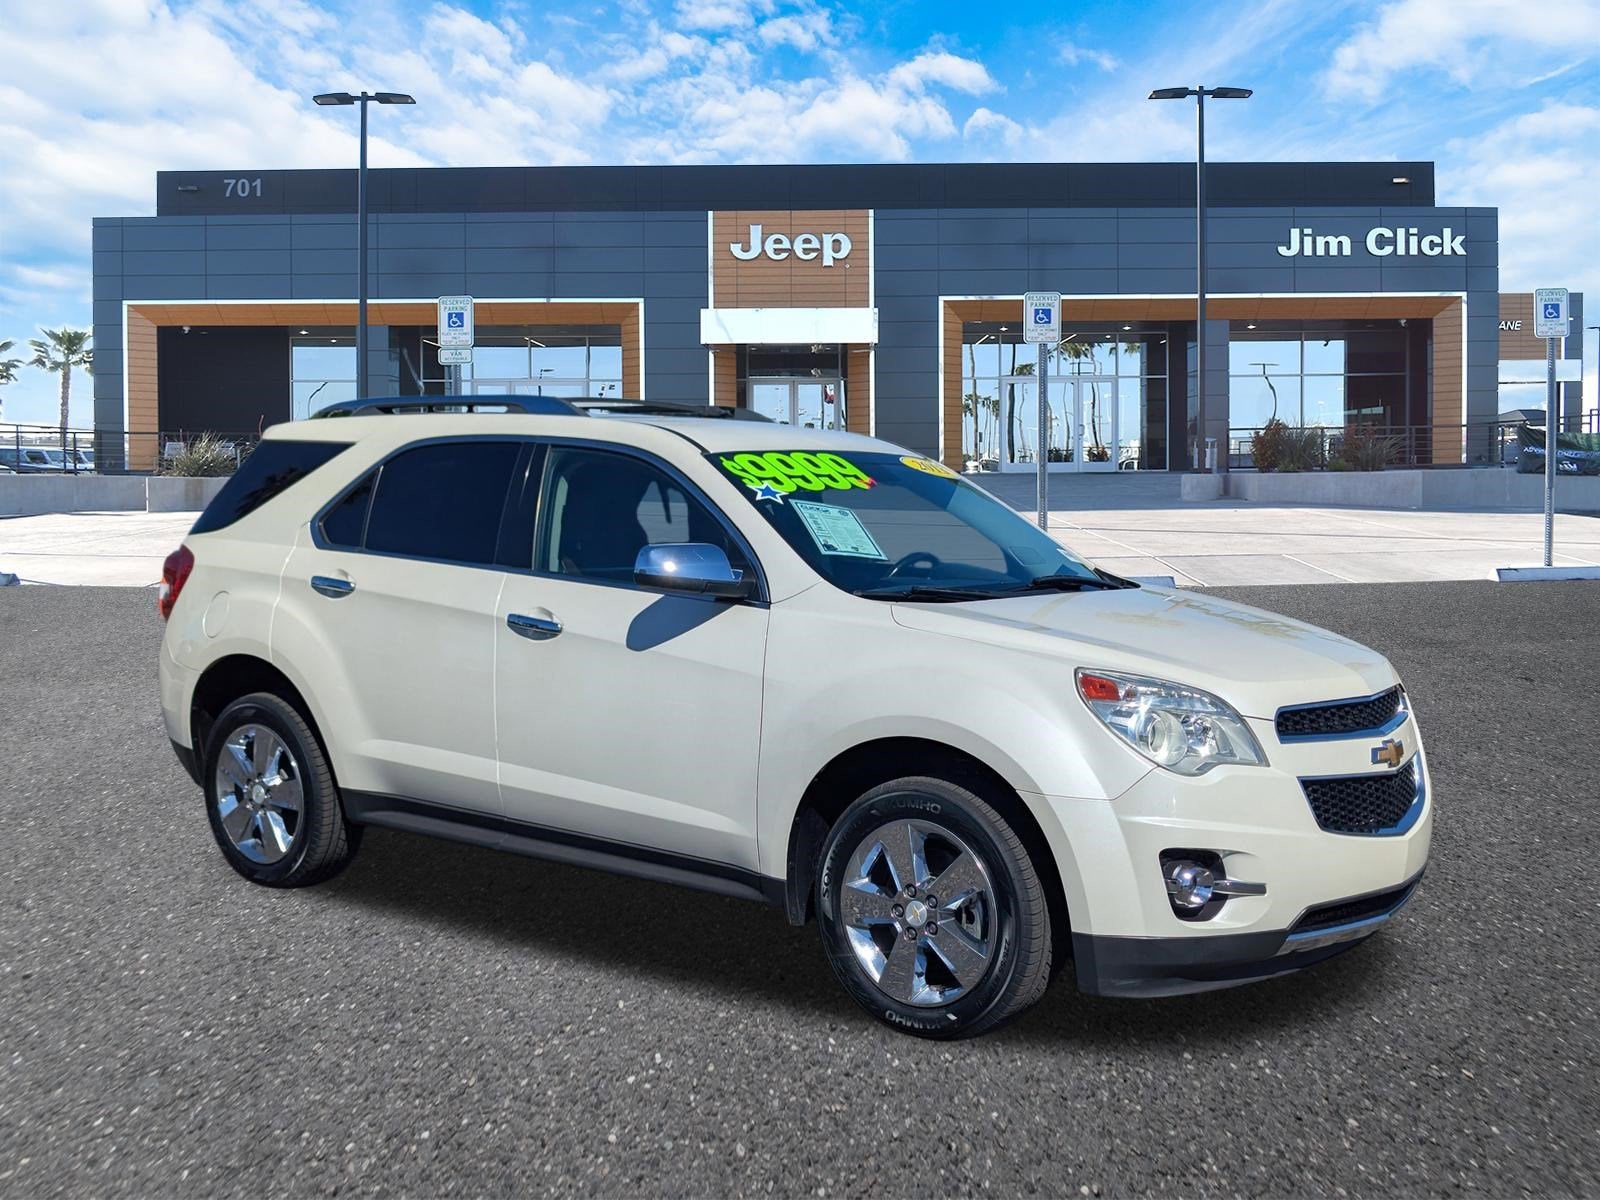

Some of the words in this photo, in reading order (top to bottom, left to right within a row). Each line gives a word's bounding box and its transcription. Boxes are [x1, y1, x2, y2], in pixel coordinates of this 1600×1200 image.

[223, 178, 262, 197] 701
[730, 224, 852, 267] Jeep
[1277, 228, 1352, 256] Jim
[1366, 227, 1467, 256] Click
[720, 452, 872, 493] $9999
